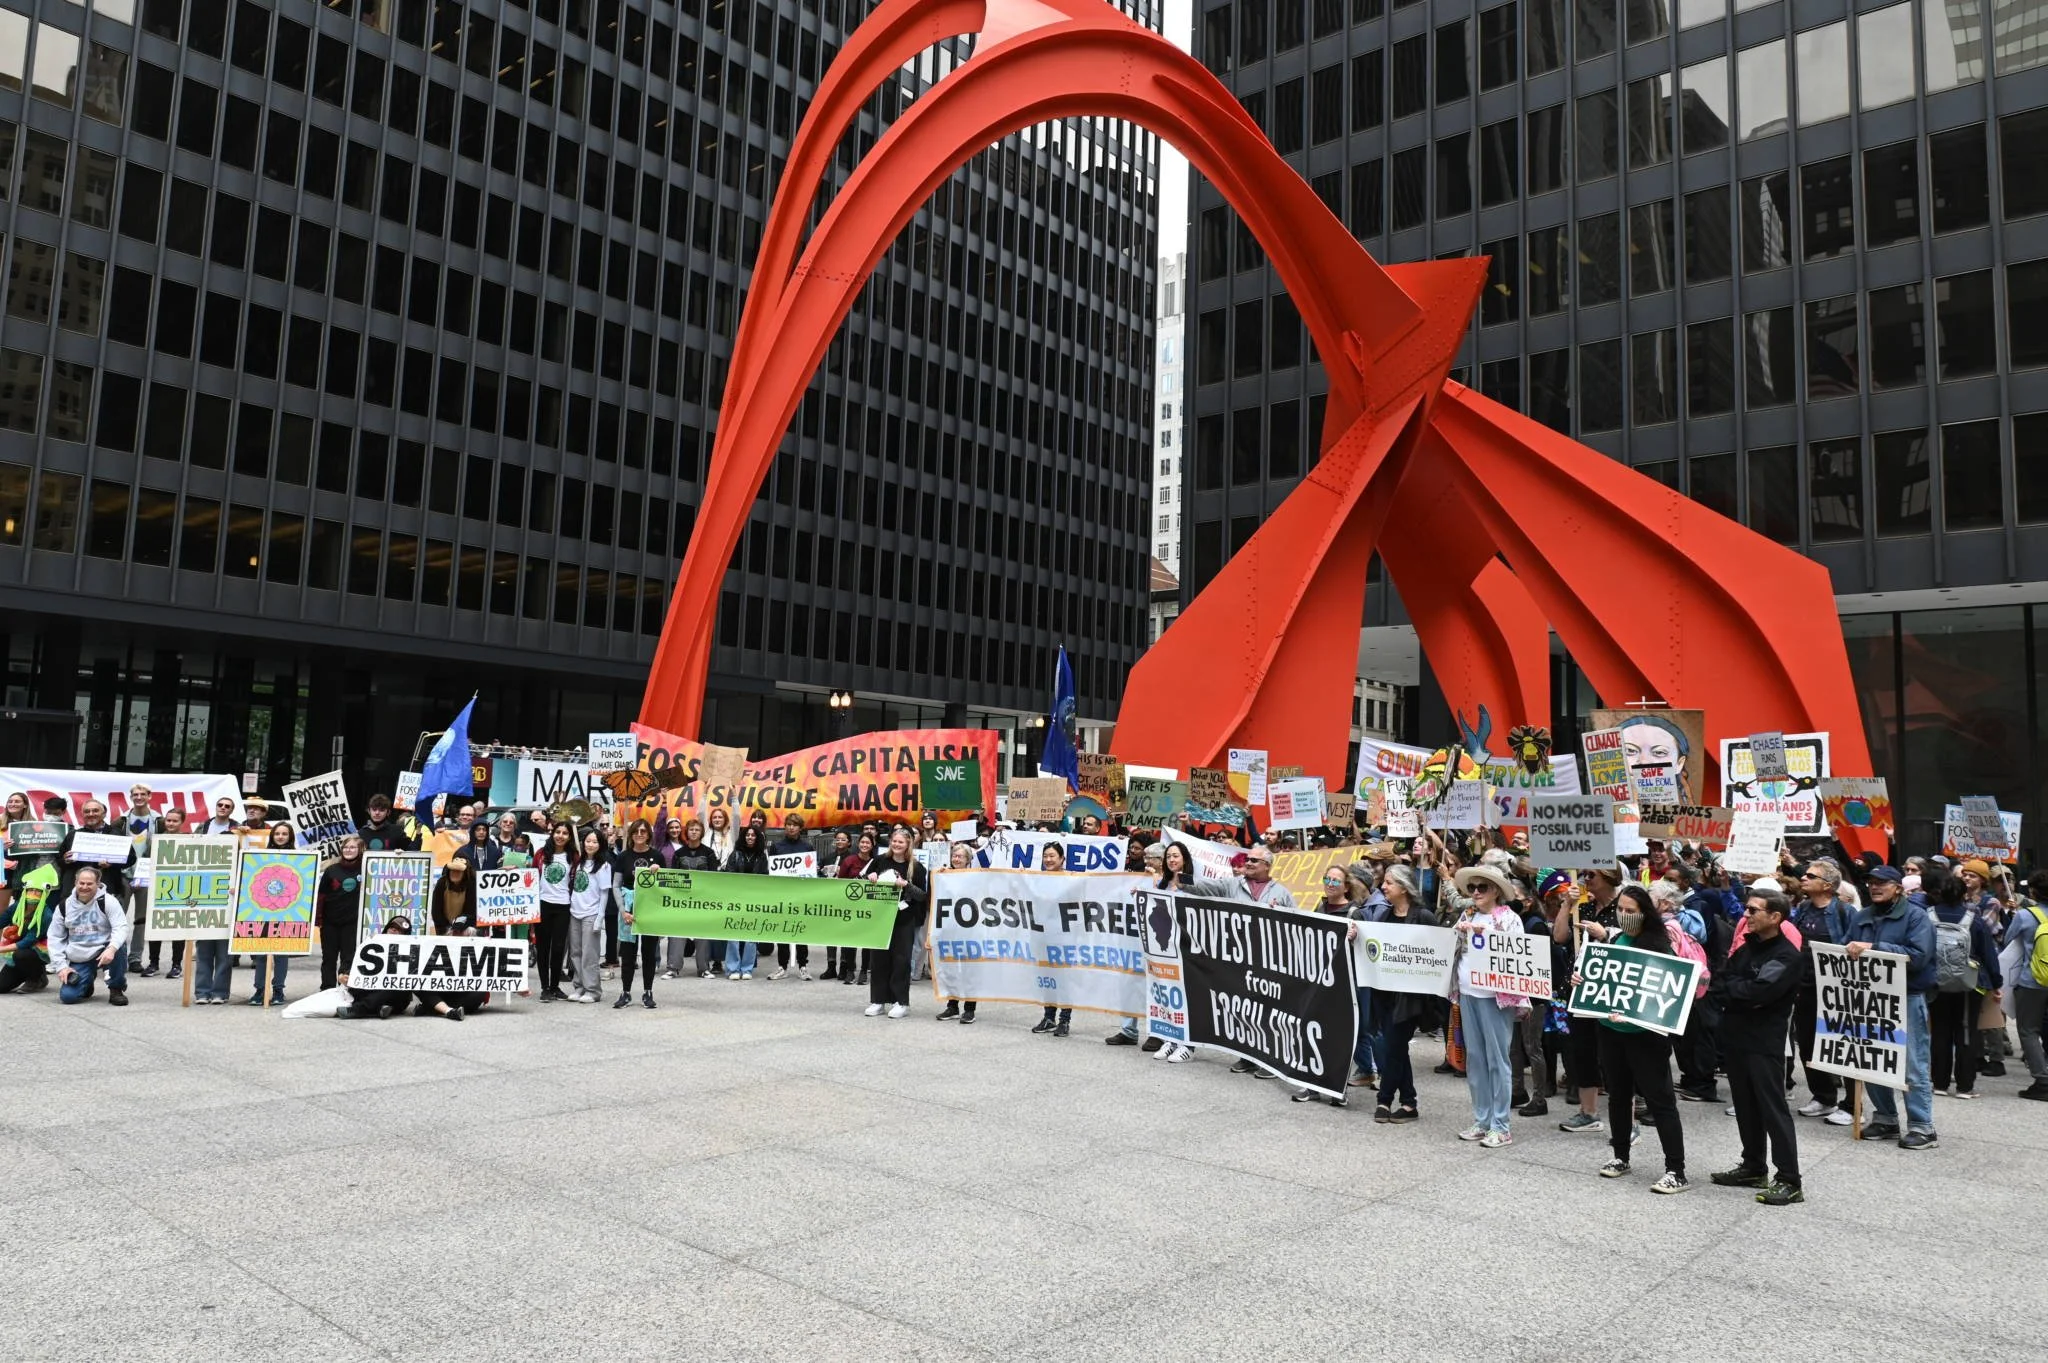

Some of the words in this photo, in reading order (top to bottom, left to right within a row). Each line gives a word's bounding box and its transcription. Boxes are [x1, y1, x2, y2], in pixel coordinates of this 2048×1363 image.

[592, 737, 633, 748] CHASE
[1585, 730, 1622, 752] CLIMATE
[1752, 737, 1780, 751] CHASE
[601, 749, 624, 759] FUNDS
[636, 742, 703, 783] FOSS
[1077, 755, 1092, 765] HIS
[1094, 756, 1103, 766] IS
[1376, 748, 1422, 777] ONL
[1760, 753, 1777, 764] FUNDS
[591, 761, 613, 769] CLIMATE
[934, 765, 967, 782] SAVE
[1640, 767, 1664, 779] SAVE
[1078, 774, 1092, 785] OT
[1093, 774, 1108, 785] GIR
[1484, 764, 1557, 788] ERYONE
[1591, 769, 1628, 787] LOVE
[288, 780, 340, 808] PROTECT
[1079, 784, 1106, 792] UMMER
[1129, 779, 1156, 793] THERE
[1159, 782, 1171, 793] IS
[1386, 779, 1410, 793] FUN
[307, 800, 328, 810] OUR
[674, 785, 694, 808] A
[1130, 795, 1152, 814] NO
[296, 802, 349, 830] CLIMATE
[1532, 804, 1556, 820] NO
[1557, 802, 1605, 819] MORE
[1640, 803, 1713, 819] ILLINOIS
[1735, 801, 1751, 813] NO
[1755, 801, 1774, 813] TAR
[1124, 813, 1165, 828] PLANET
[1531, 823, 1573, 836] FOSSIL
[1575, 822, 1610, 836] FUEL
[1640, 814, 1675, 826] NEEDS
[301, 820, 351, 845] WATER
[157, 839, 232, 865] NATURE
[1548, 839, 1593, 853] LOANS
[770, 856, 803, 871] STOP
[1011, 842, 1122, 873] NEDS
[366, 858, 429, 877] CLIMATE
[154, 873, 231, 900] RULE
[365, 878, 428, 896] JUSTICE
[479, 872, 521, 890] STOP
[478, 894, 537, 908] MONEY
[661, 895, 724, 911] Business
[726, 902, 742, 912] as
[746, 901, 784, 914] usual
[787, 903, 800, 915] is
[804, 904, 851, 921] killing
[856, 906, 872, 920] us
[152, 909, 229, 930] RENEWAL
[488, 906, 530, 918] PIPELINE
[935, 897, 1045, 933] FOSSIL
[1058, 900, 1140, 938] FREE
[233, 921, 266, 938] NEW
[267, 921, 311, 938] EARTH
[724, 916, 758, 931] Rebel
[759, 919, 779, 935] for
[782, 920, 807, 937] Life
[1185, 905, 1253, 967] DIVEST
[1257, 916, 1339, 988] ILLINOIS
[1382, 942, 1398, 953] The
[1398, 943, 1435, 955] Climate
[1489, 934, 1533, 956] CHASE
[1590, 946, 1609, 957] Vote
[357, 943, 523, 978] SHAME
[937, 939, 1037, 962] FEDERAL
[1046, 944, 1146, 974] RESERVE
[1382, 953, 1413, 966] Reality
[1415, 955, 1448, 968] Project
[1489, 956, 1534, 977] FUELS
[1537, 967, 1551, 979] THE
[1816, 952, 1897, 985] PROTECT
[382, 977, 427, 990] GREEDY
[430, 977, 483, 991] BASTARD
[486, 978, 523, 992] PARTY
[1037, 976, 1057, 990] 350
[1470, 971, 1516, 991] CLIMATE
[1518, 978, 1550, 996] CRISIS
[1584, 957, 1686, 997] GREEN
[1840, 978, 1872, 991] OUR
[1152, 981, 1184, 1010] 350
[1244, 972, 1282, 1001] from
[1579, 981, 1677, 1019] PARTY
[1209, 988, 1271, 1055] FOSSIL
[1267, 1006, 1325, 1077] FUELS
[1822, 1010, 1897, 1044] WATER
[1840, 1035, 1873, 1047] AND
[1819, 1039, 1898, 1075] HEALTH
